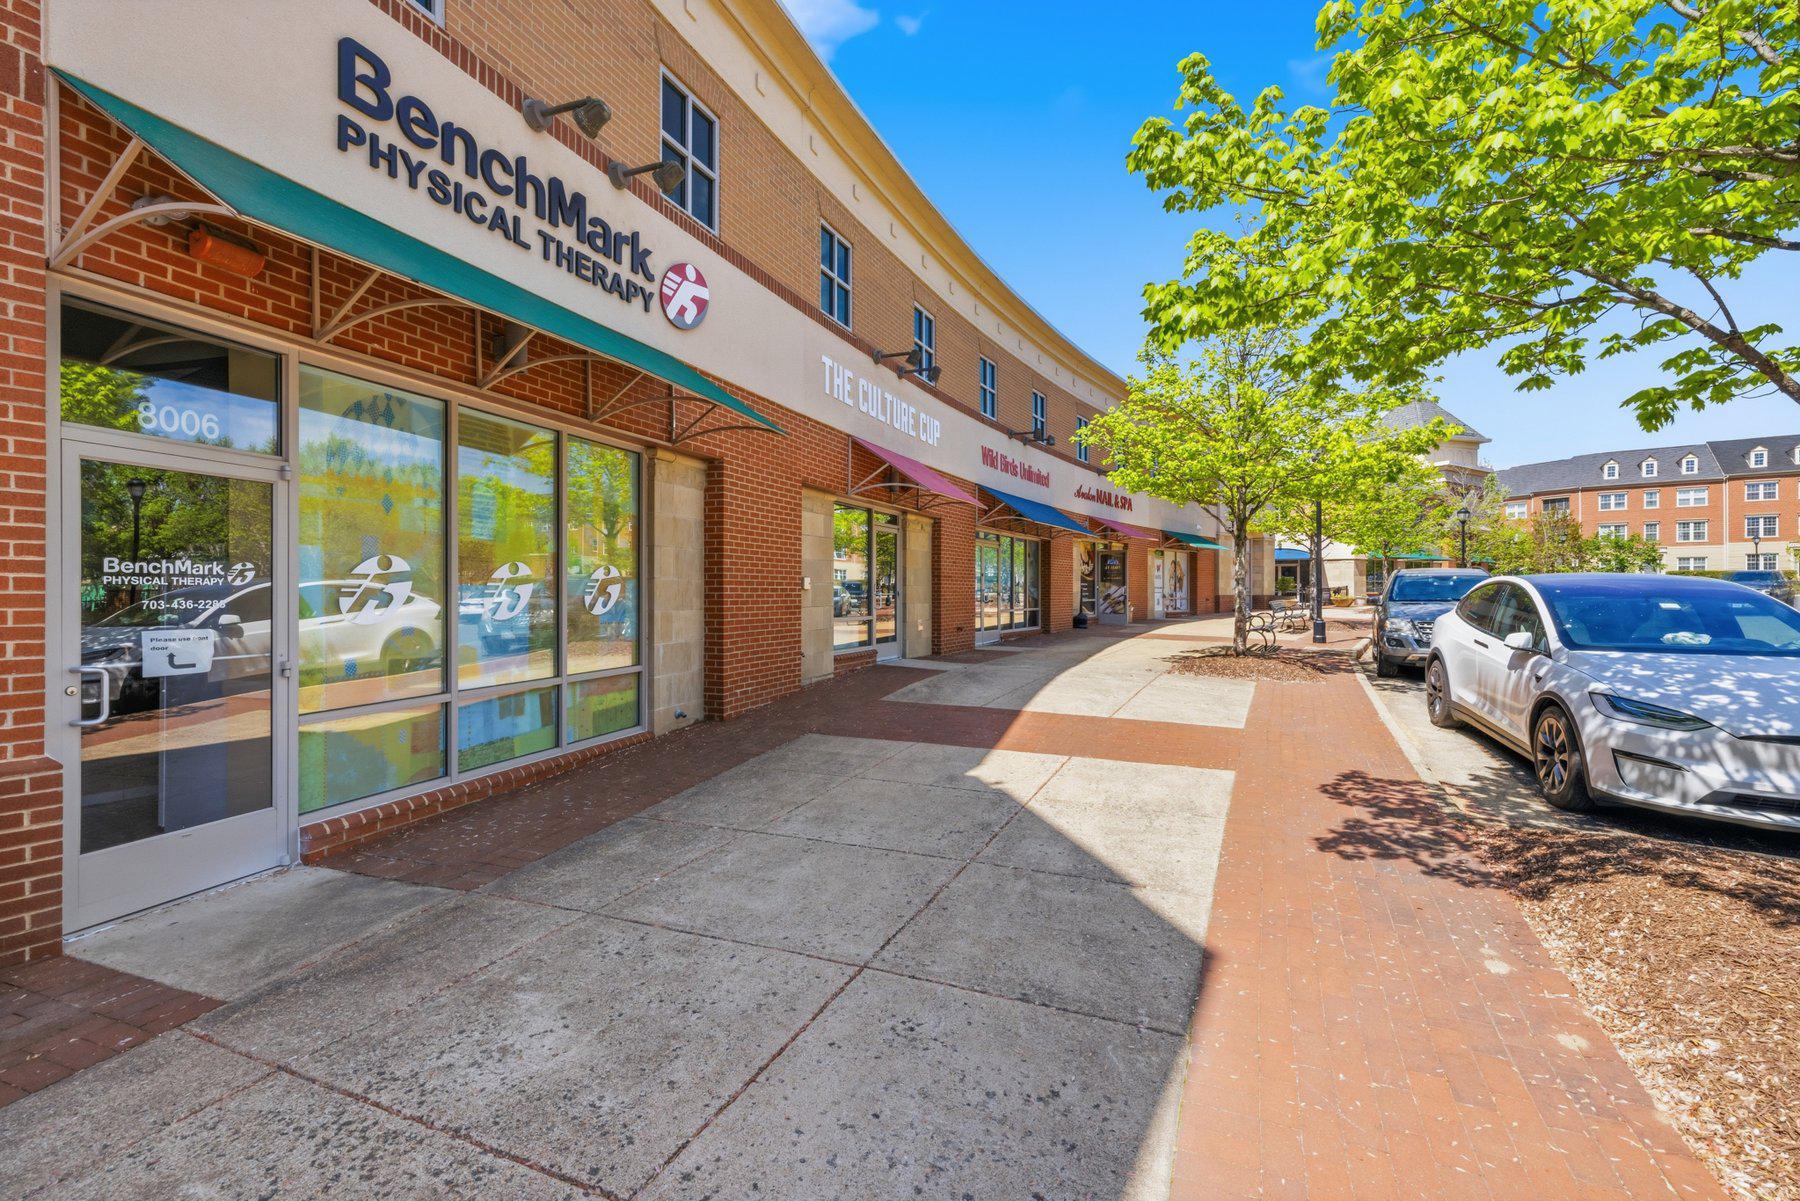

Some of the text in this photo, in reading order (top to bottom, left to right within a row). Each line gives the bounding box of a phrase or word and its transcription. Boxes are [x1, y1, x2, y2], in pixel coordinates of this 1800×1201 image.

[338, 37, 655, 283] BenchMark
[338, 115, 655, 312] PHYSICAL THERAPY
[137, 402, 220, 439] 8006
[821, 355, 940, 447] THE CULTURE CUP
[981, 445, 1050, 488] Wild Birds Unlimited
[1096, 488, 1113, 507] NAIL
[1114, 494, 1119, 509] &
[1120, 495, 1133, 512] SPA
[103, 557, 224, 575] BenchMark
[103, 576, 224, 586] PHYSICAL THERAPY
